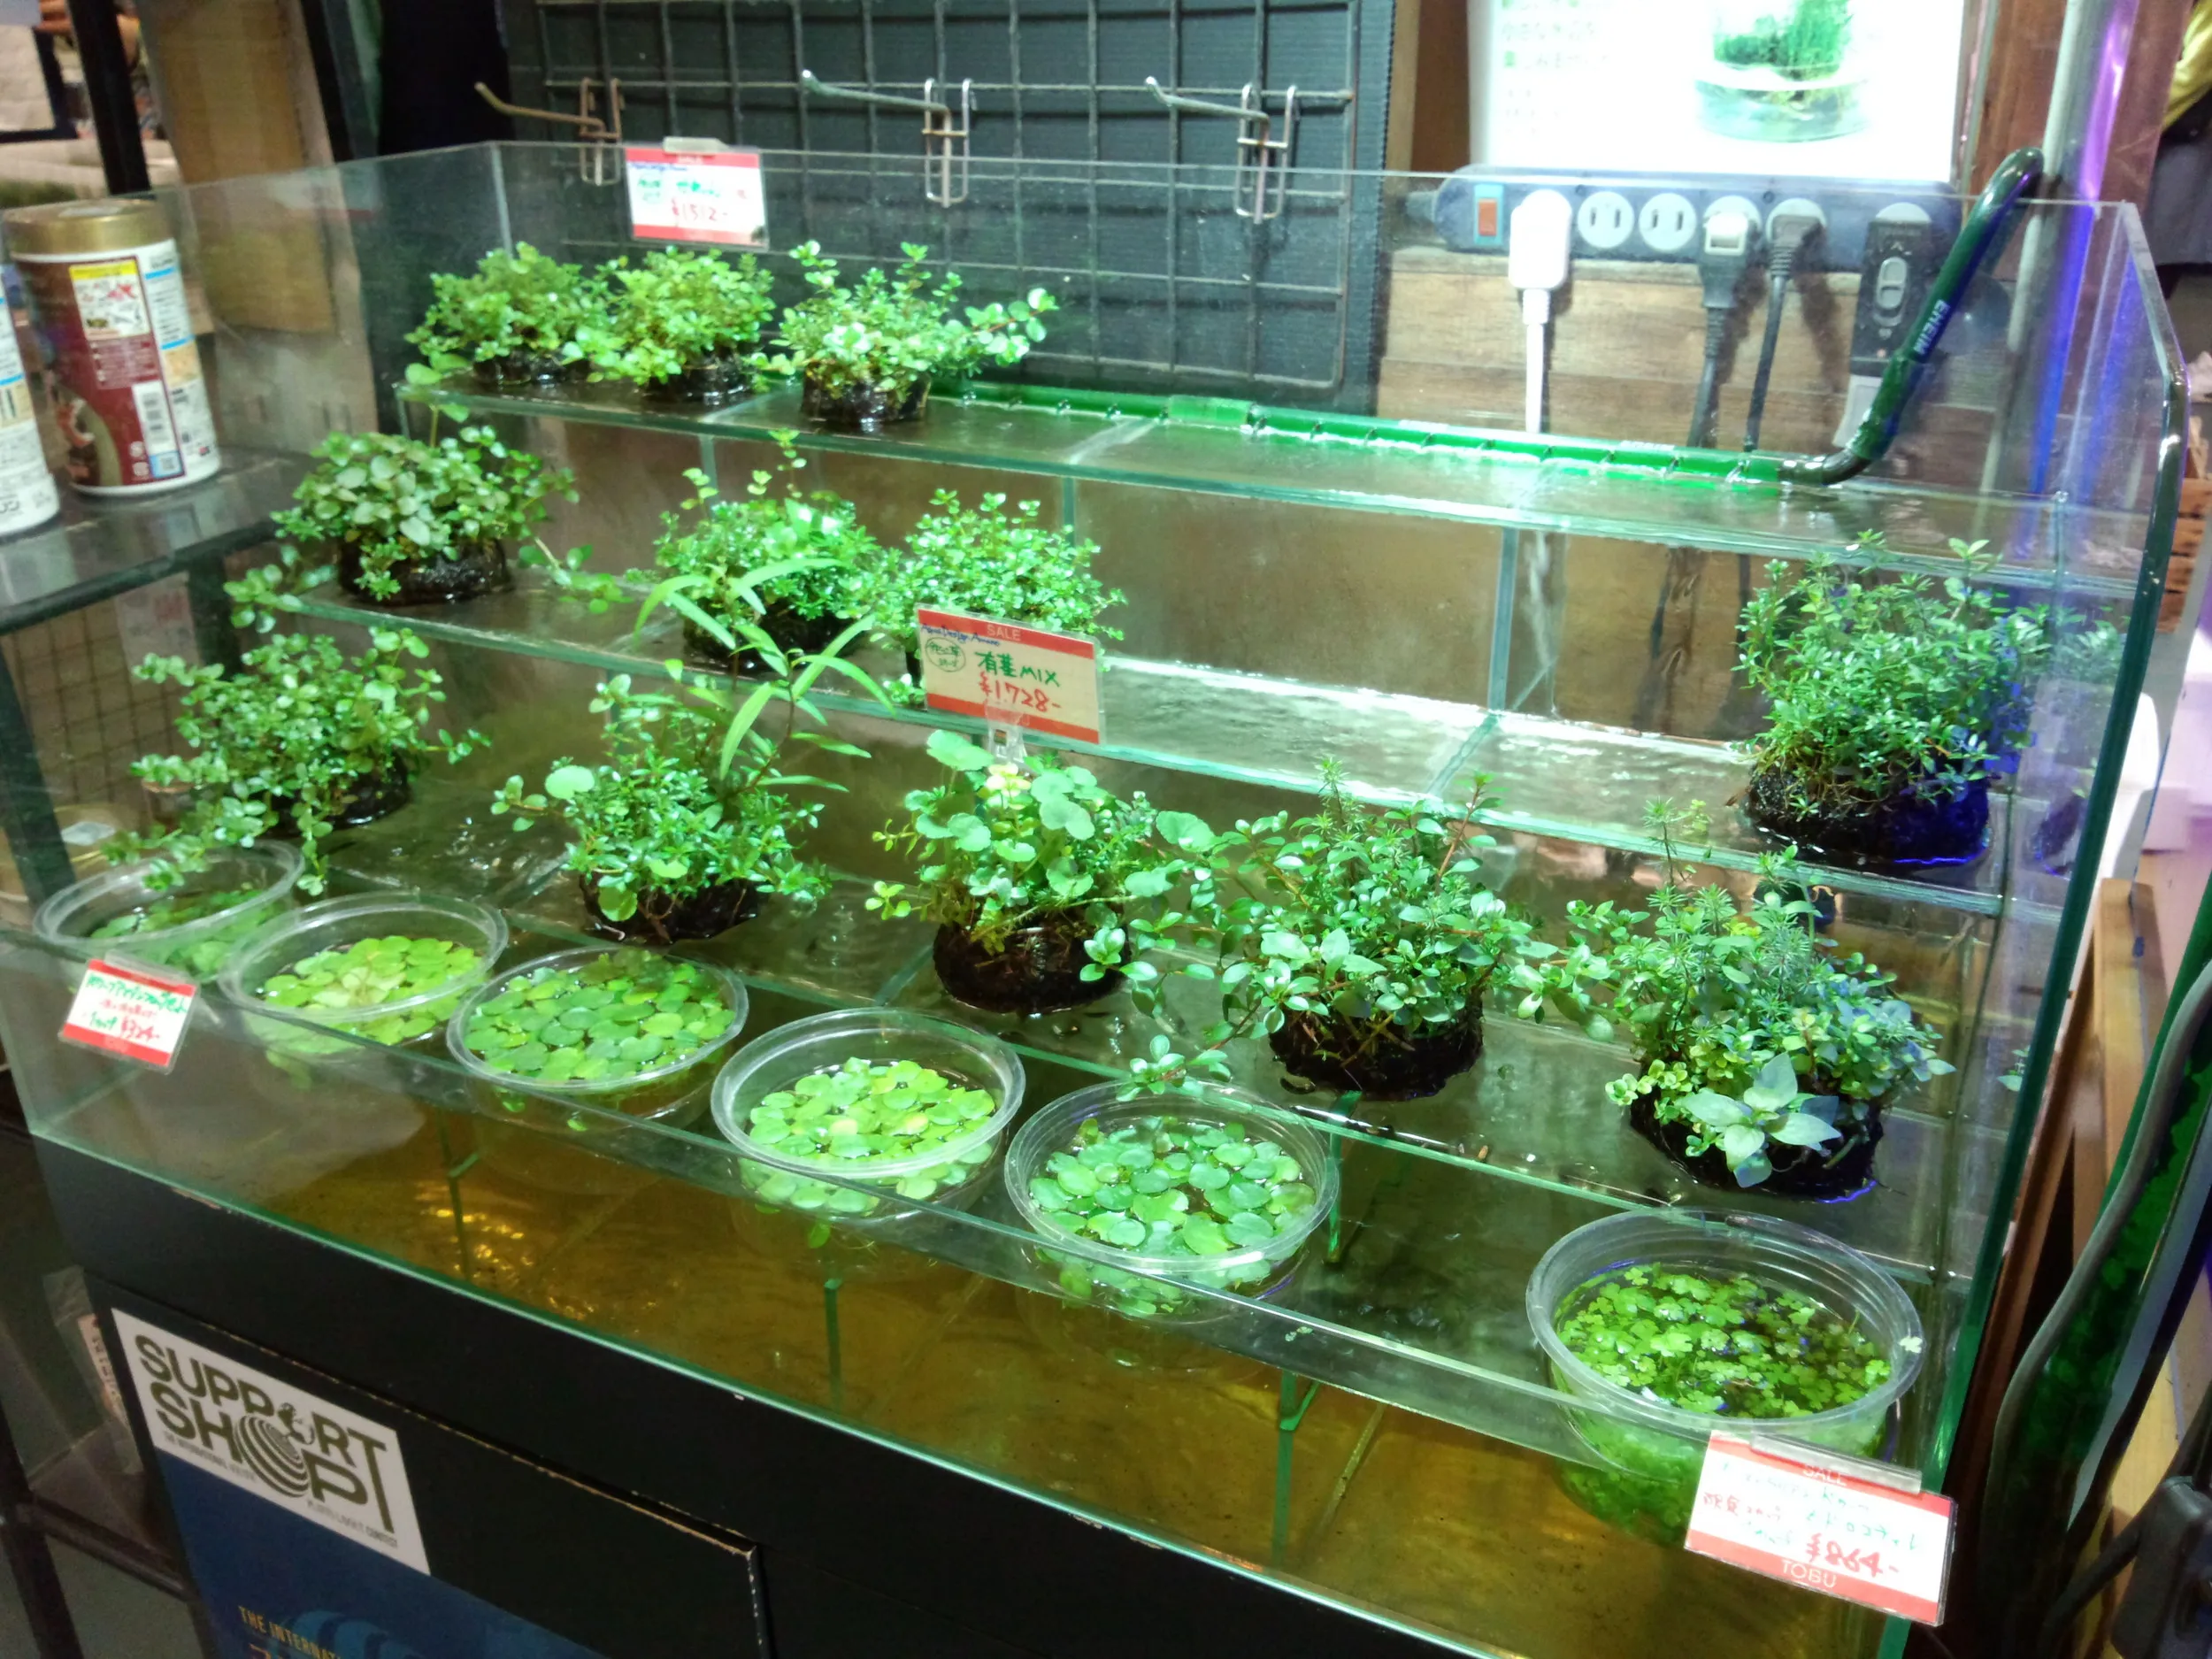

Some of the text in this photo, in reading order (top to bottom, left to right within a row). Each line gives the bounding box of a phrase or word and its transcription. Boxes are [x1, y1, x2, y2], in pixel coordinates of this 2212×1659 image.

[1913, 299, 1951, 356] EHEIM
[986, 623, 1022, 642] SALE
[1781, 1560, 1838, 1589] TOBU
[237, 1604, 267, 1634] THE
[268, 1620, 344, 1659] INTERNAT
